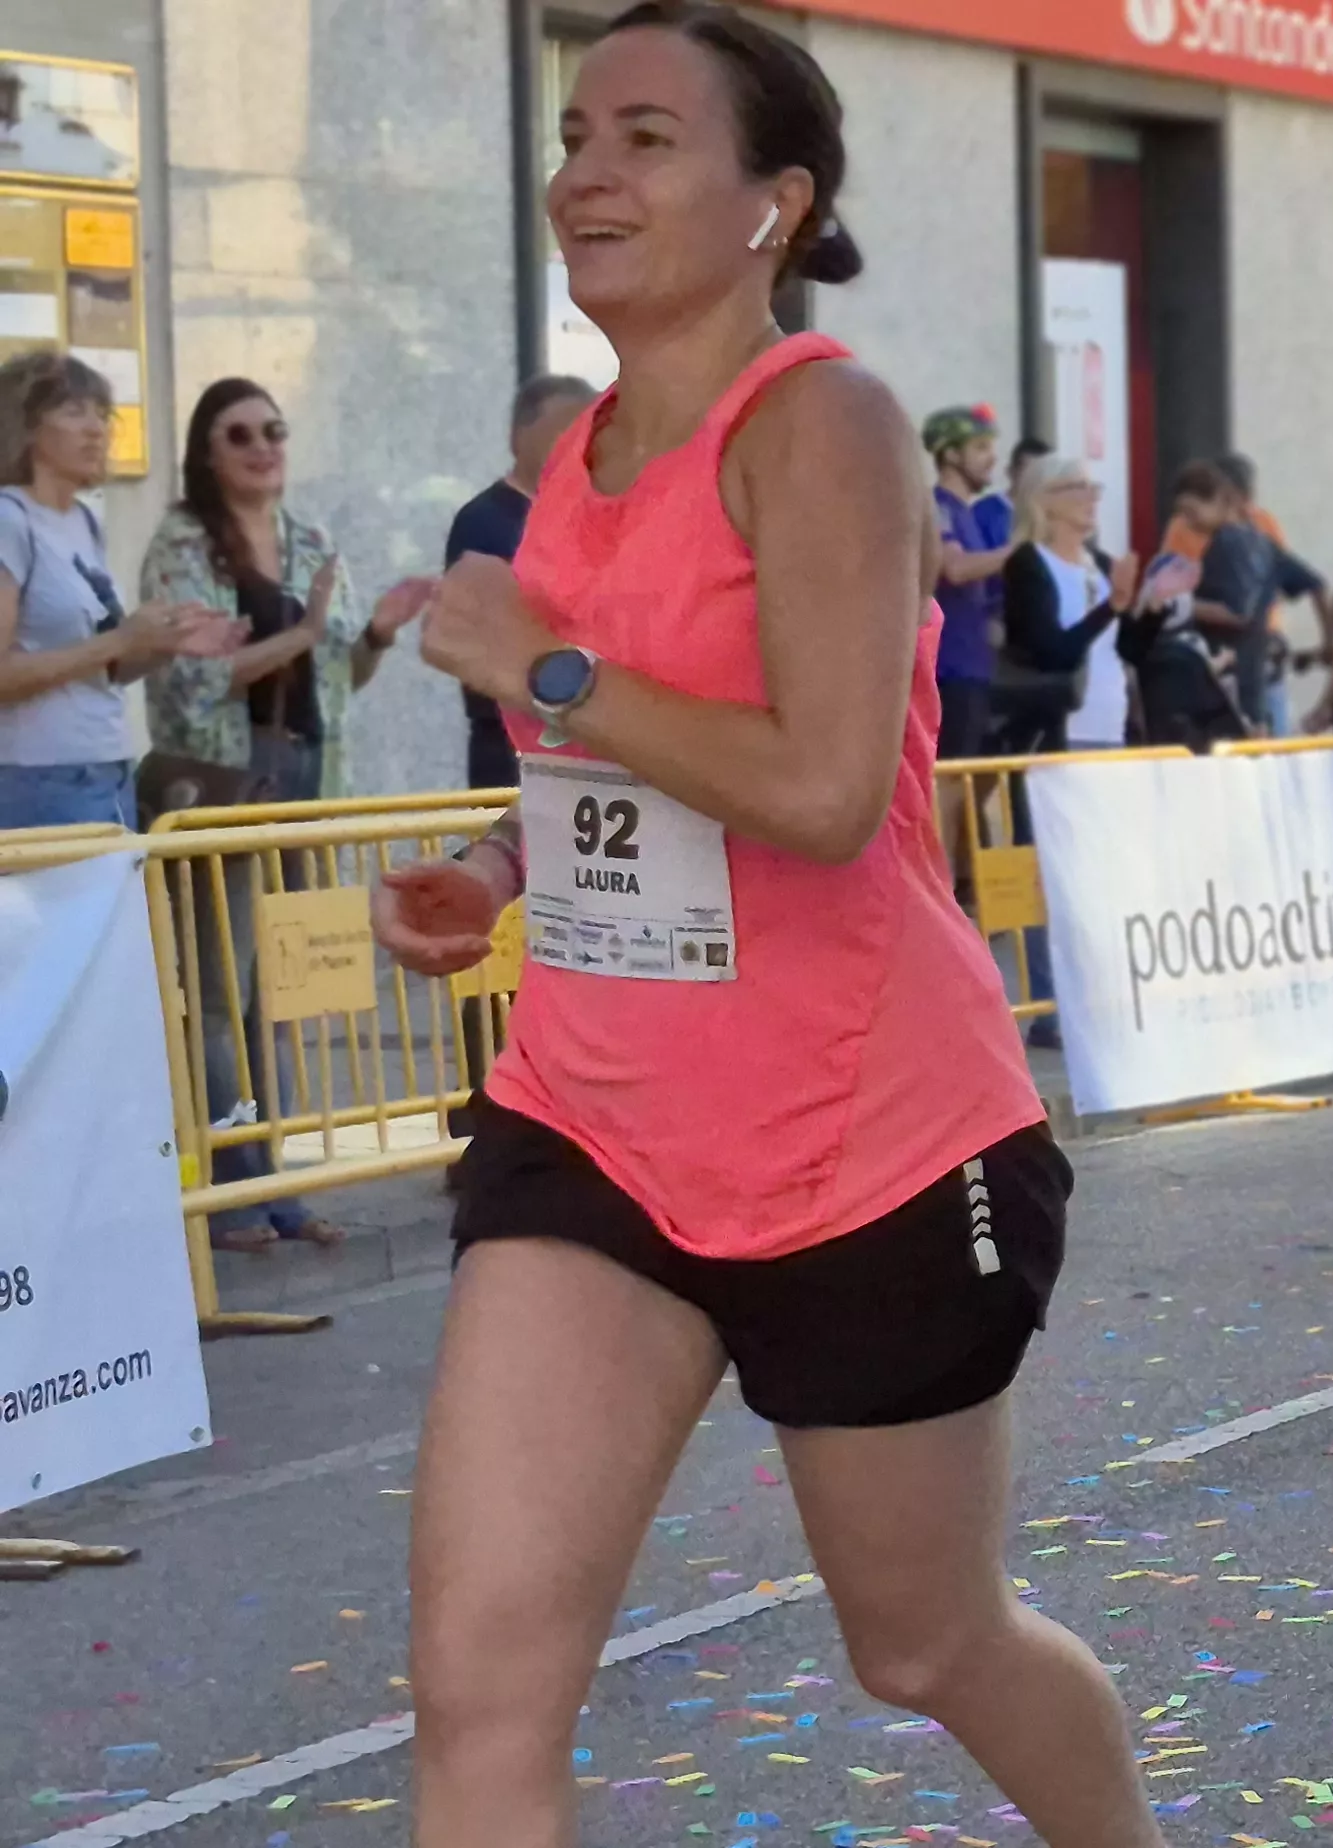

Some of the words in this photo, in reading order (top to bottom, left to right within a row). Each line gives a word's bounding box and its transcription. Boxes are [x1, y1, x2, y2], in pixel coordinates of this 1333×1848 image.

[574, 796, 640, 859] 92
[574, 866, 641, 895] LAURA
[0, 1349, 152, 1423] avanza.com
